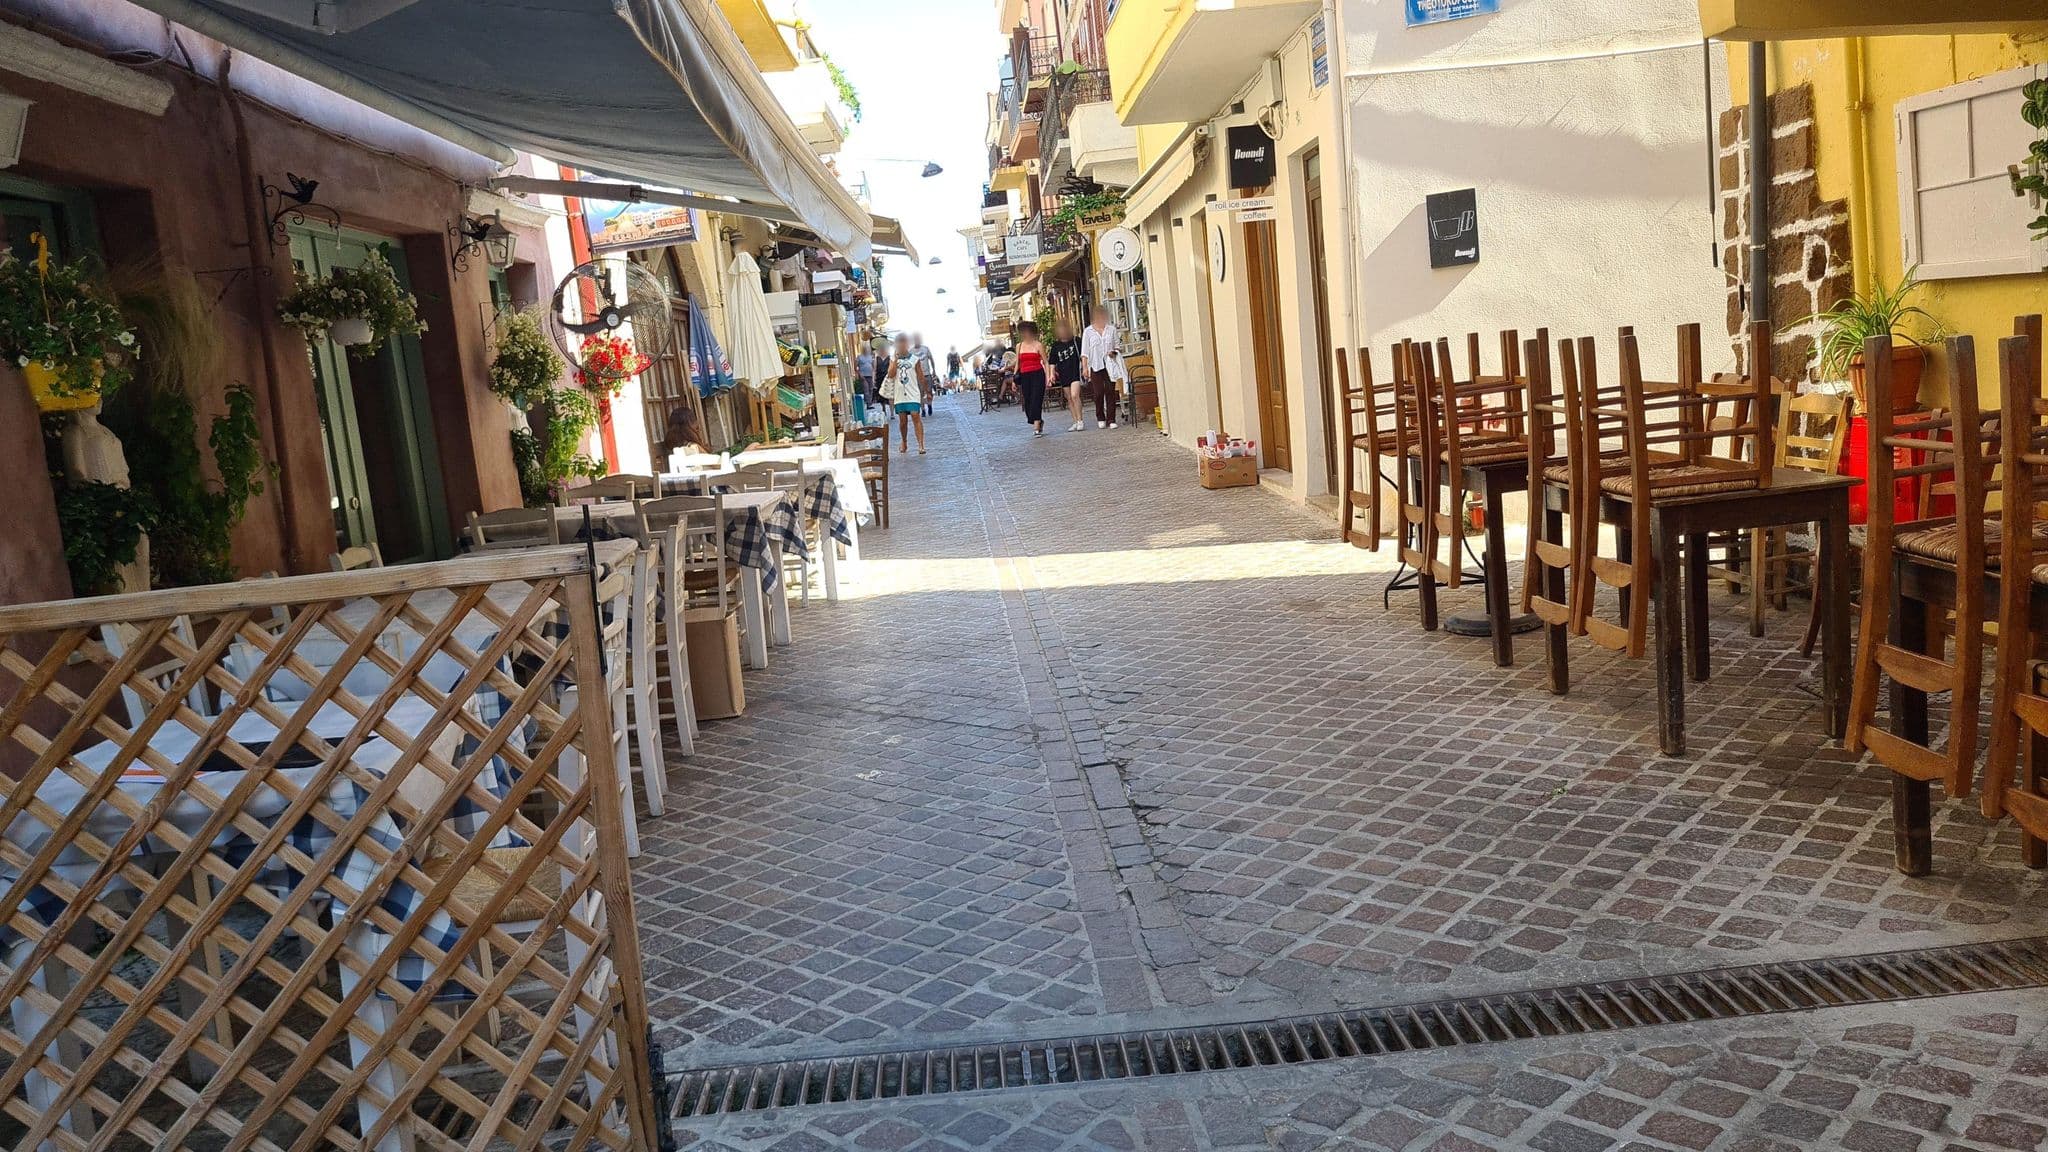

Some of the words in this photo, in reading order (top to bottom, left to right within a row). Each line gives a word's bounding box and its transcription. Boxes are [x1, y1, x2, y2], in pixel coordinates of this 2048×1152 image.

[1416, 0, 1477, 11] THEOTOKO
[1234, 146, 1265, 160] Buondi
[1215, 201, 1227, 210] roll
[1241, 199, 1266, 208] cream
[1243, 211, 1267, 220] coffee
